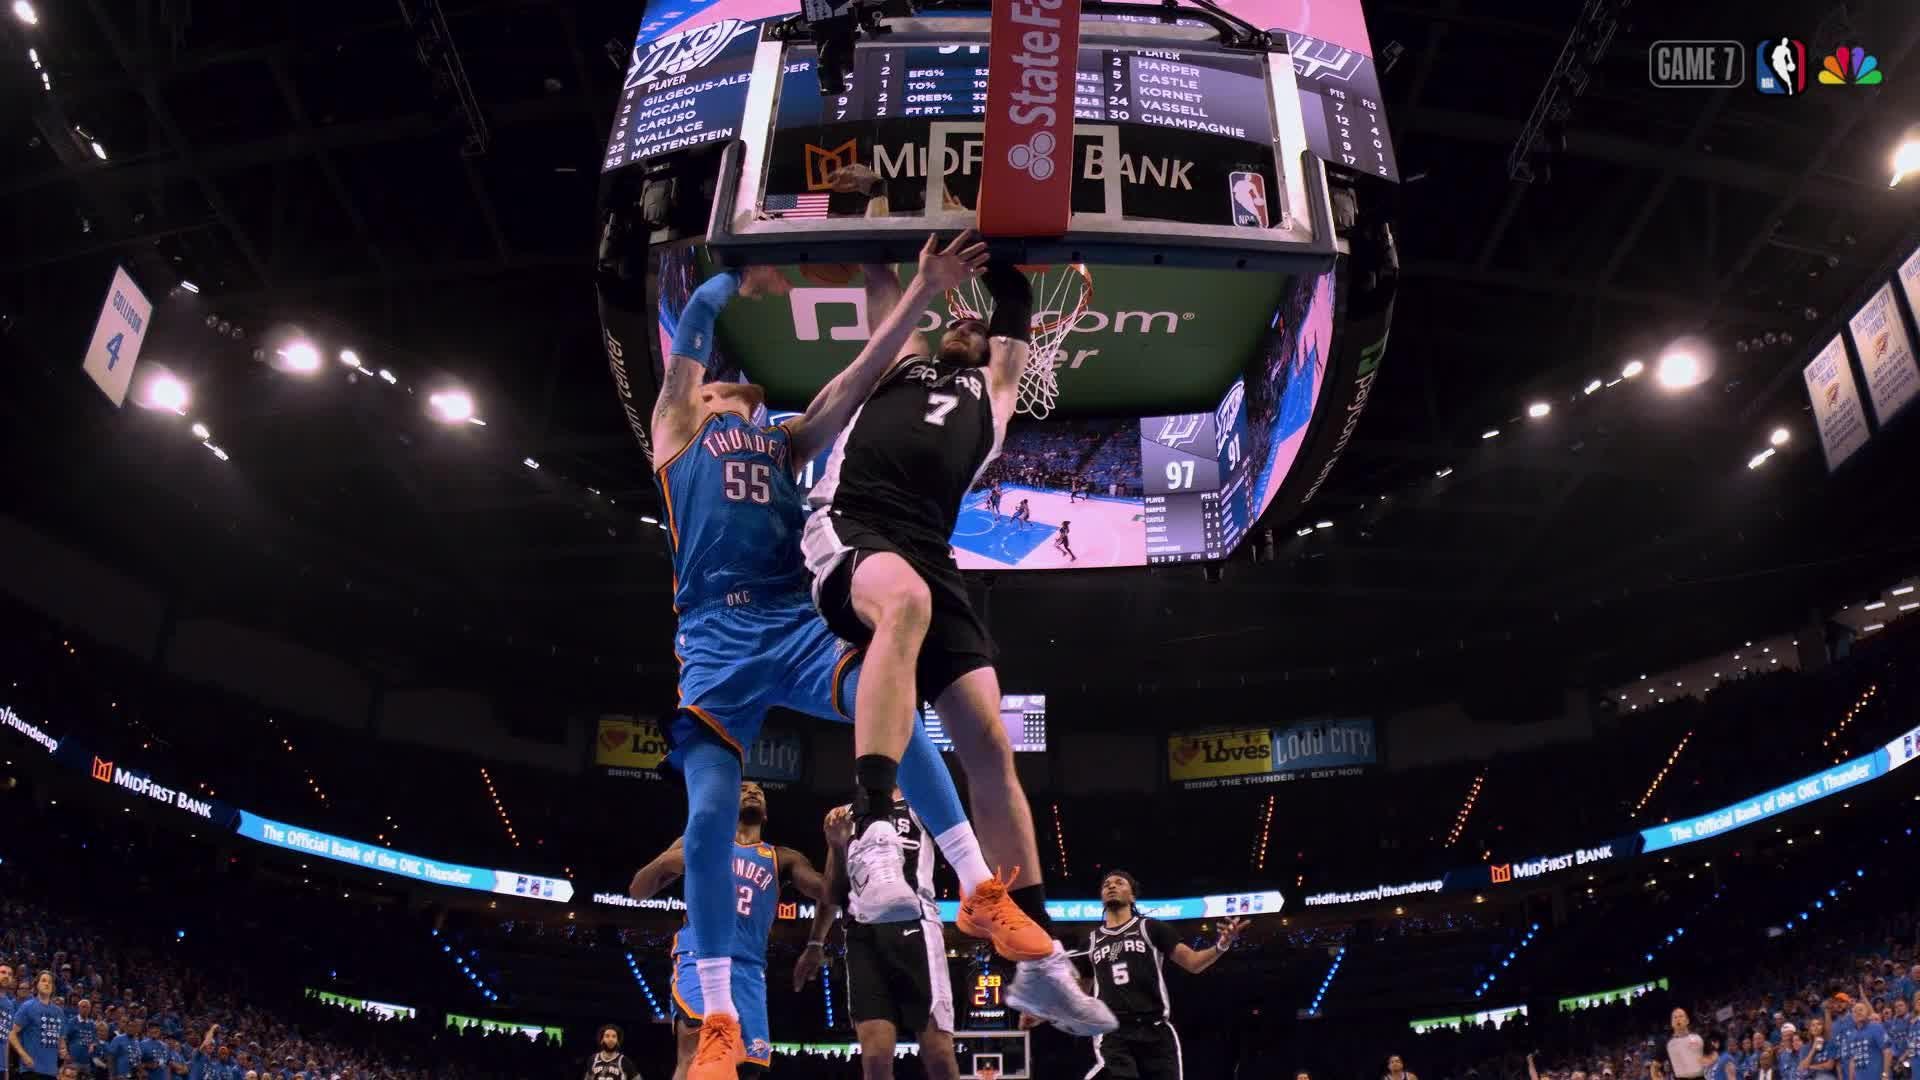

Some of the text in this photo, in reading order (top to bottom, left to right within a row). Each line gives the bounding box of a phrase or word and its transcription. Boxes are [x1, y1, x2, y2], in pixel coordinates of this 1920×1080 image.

[884, 53, 890, 61] 1
[1113, 58, 1199, 78] 2 HARPER
[881, 67, 890, 75] 2
[909, 69, 944, 78] EFG%
[1113, 70, 1198, 90] 5 CASTLE
[648, 74, 687, 93] PLAYER
[882, 80, 888, 88] 1
[908, 81, 936, 90] TO%
[1114, 84, 1203, 103] 7 KORNET
[838, 93, 888, 105] 9 2
[907, 93, 952, 102] OREB%
[1109, 97, 1208, 118] 24 VASSELL
[1329, 88, 1377, 110] PTS FLS
[619, 97, 696, 126] 3 MCCAIN
[622, 105, 631, 114] 2
[837, 107, 886, 119] 7 2
[905, 107, 921, 115] FT
[1336, 103, 1375, 123] 7 1
[616, 110, 696, 140] 9 CARUSO
[1109, 110, 1246, 138] 30 CHAMPAGNIE
[1335, 114, 1379, 136] 12 4
[605, 128, 733, 168] 55 HARTENSTEIN
[609, 121, 704, 154] 22 WALLACE
[1341, 129, 1382, 149] 2 0
[1343, 142, 1383, 161] 9 1
[1342, 154, 1387, 176] 17 2
[113, 290, 143, 334] COLLISON
[106, 332, 124, 371] 4
[606, 328, 633, 399] center
[924, 392, 959, 426] 7
[703, 428, 787, 463] THUNDER
[1228, 434, 1241, 471] 91
[724, 460, 770, 503] 55
[1166, 461, 1194, 490] 97
[727, 590, 750, 607] OKC
[1276, 727, 1370, 765] LOUD CITY
[1222, 778, 1241, 787] THE
[1243, 774, 1295, 784] THUNDER
[1311, 770, 1336, 779] EXIT
[1669, 763, 1871, 842] The Official Bank of the OKC Thunder
[263, 824, 473, 884] The Official Bank of the OKC Thunder
[730, 857, 773, 891] NDER
[1305, 879, 1444, 907] midfirst.com/thunderup
[1111, 963, 1129, 985] 5
[975, 986, 999, 1005] 21
